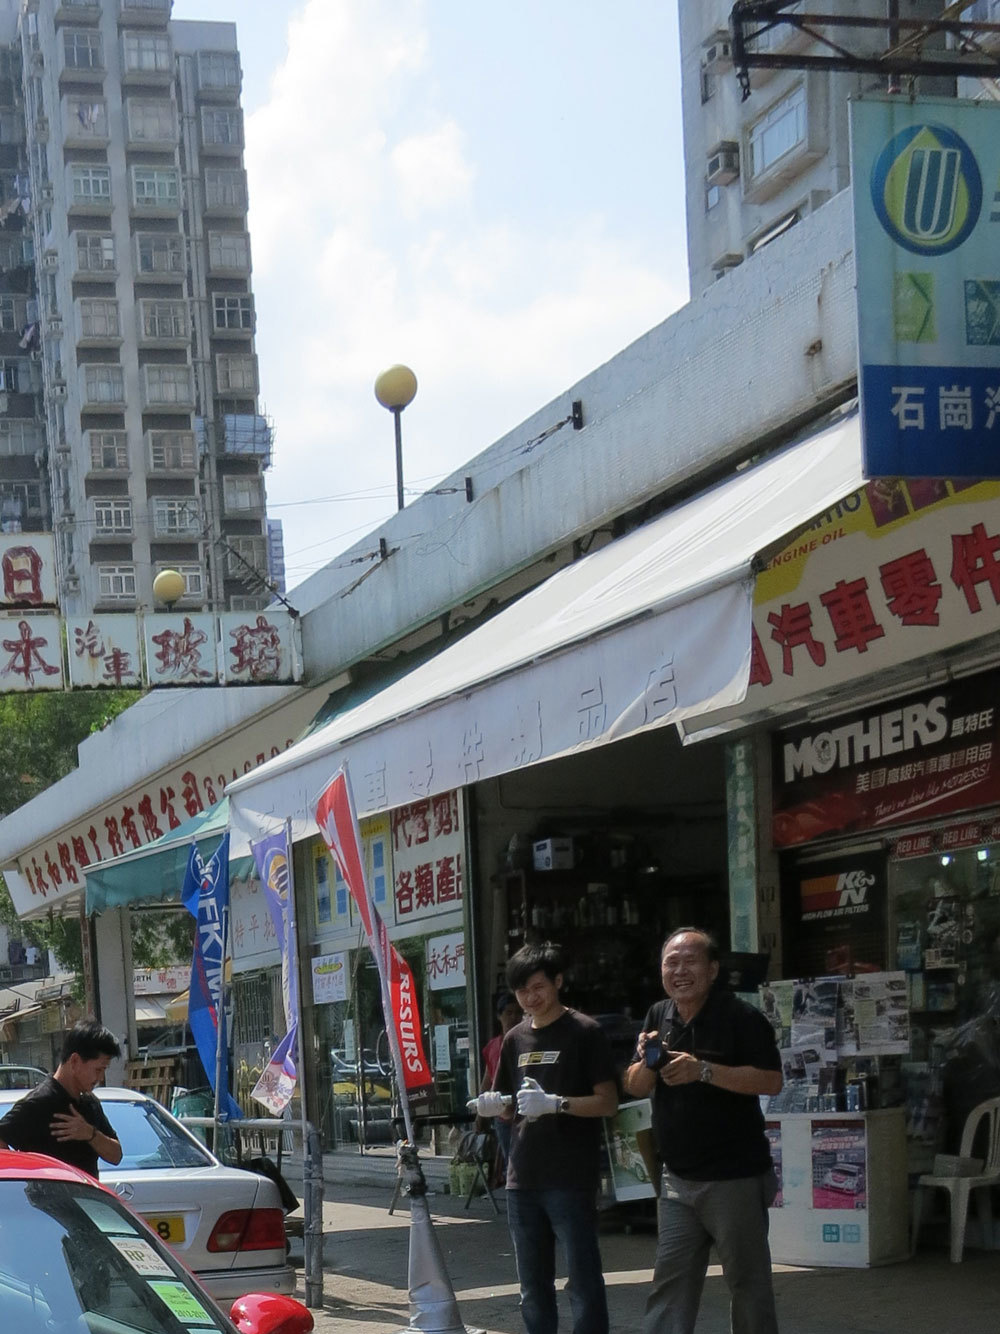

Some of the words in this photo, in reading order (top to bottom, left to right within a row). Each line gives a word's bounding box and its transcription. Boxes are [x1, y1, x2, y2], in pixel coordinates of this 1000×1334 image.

[822, 527, 848, 546] OIL
[783, 696, 948, 784] MOTHERS
[942, 830, 959, 844] RED
[960, 825, 979, 840] LINE
[400, 973, 423, 1073] RESURS
[156, 1221, 171, 1241] 8
